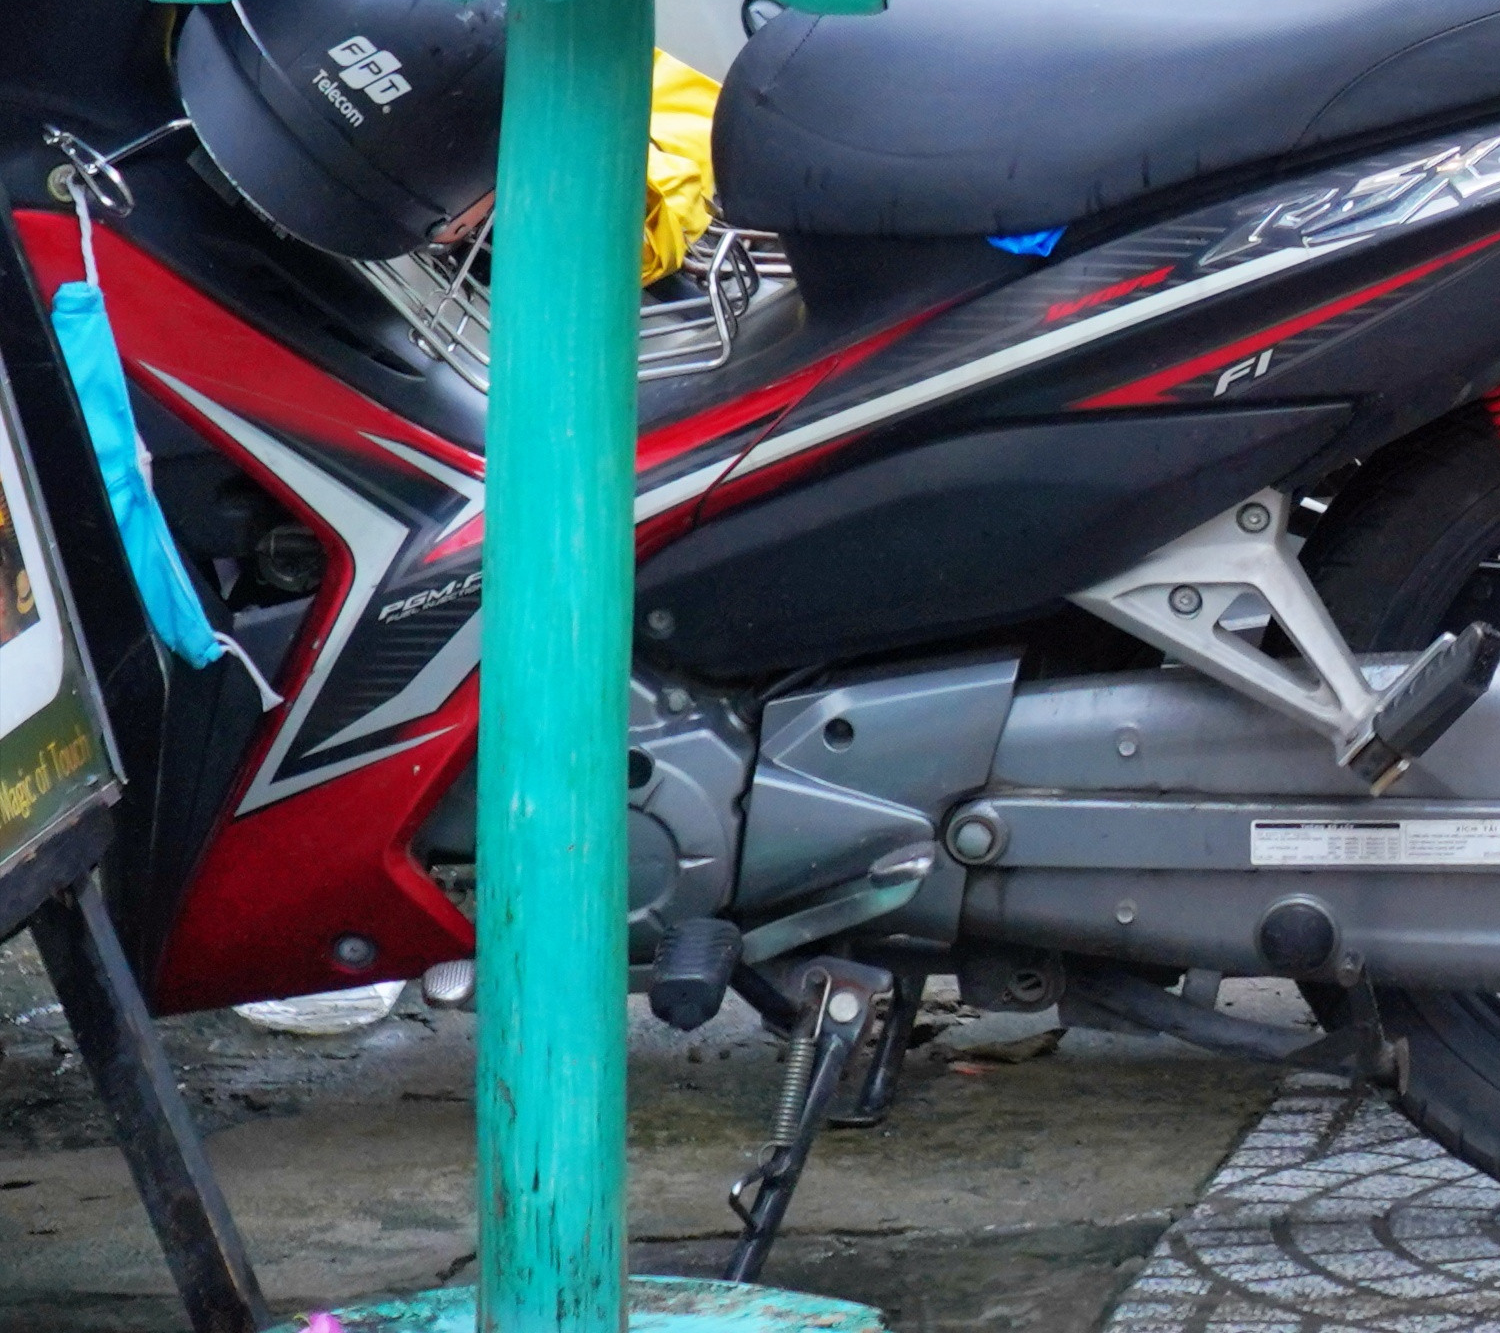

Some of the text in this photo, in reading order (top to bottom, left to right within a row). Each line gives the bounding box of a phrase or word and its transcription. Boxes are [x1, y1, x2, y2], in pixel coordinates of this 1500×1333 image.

[312, 68, 365, 128] Telecom
[1212, 348, 1274, 398] FI
[35, 750, 52, 795] of
[47, 723, 93, 782] Touch
